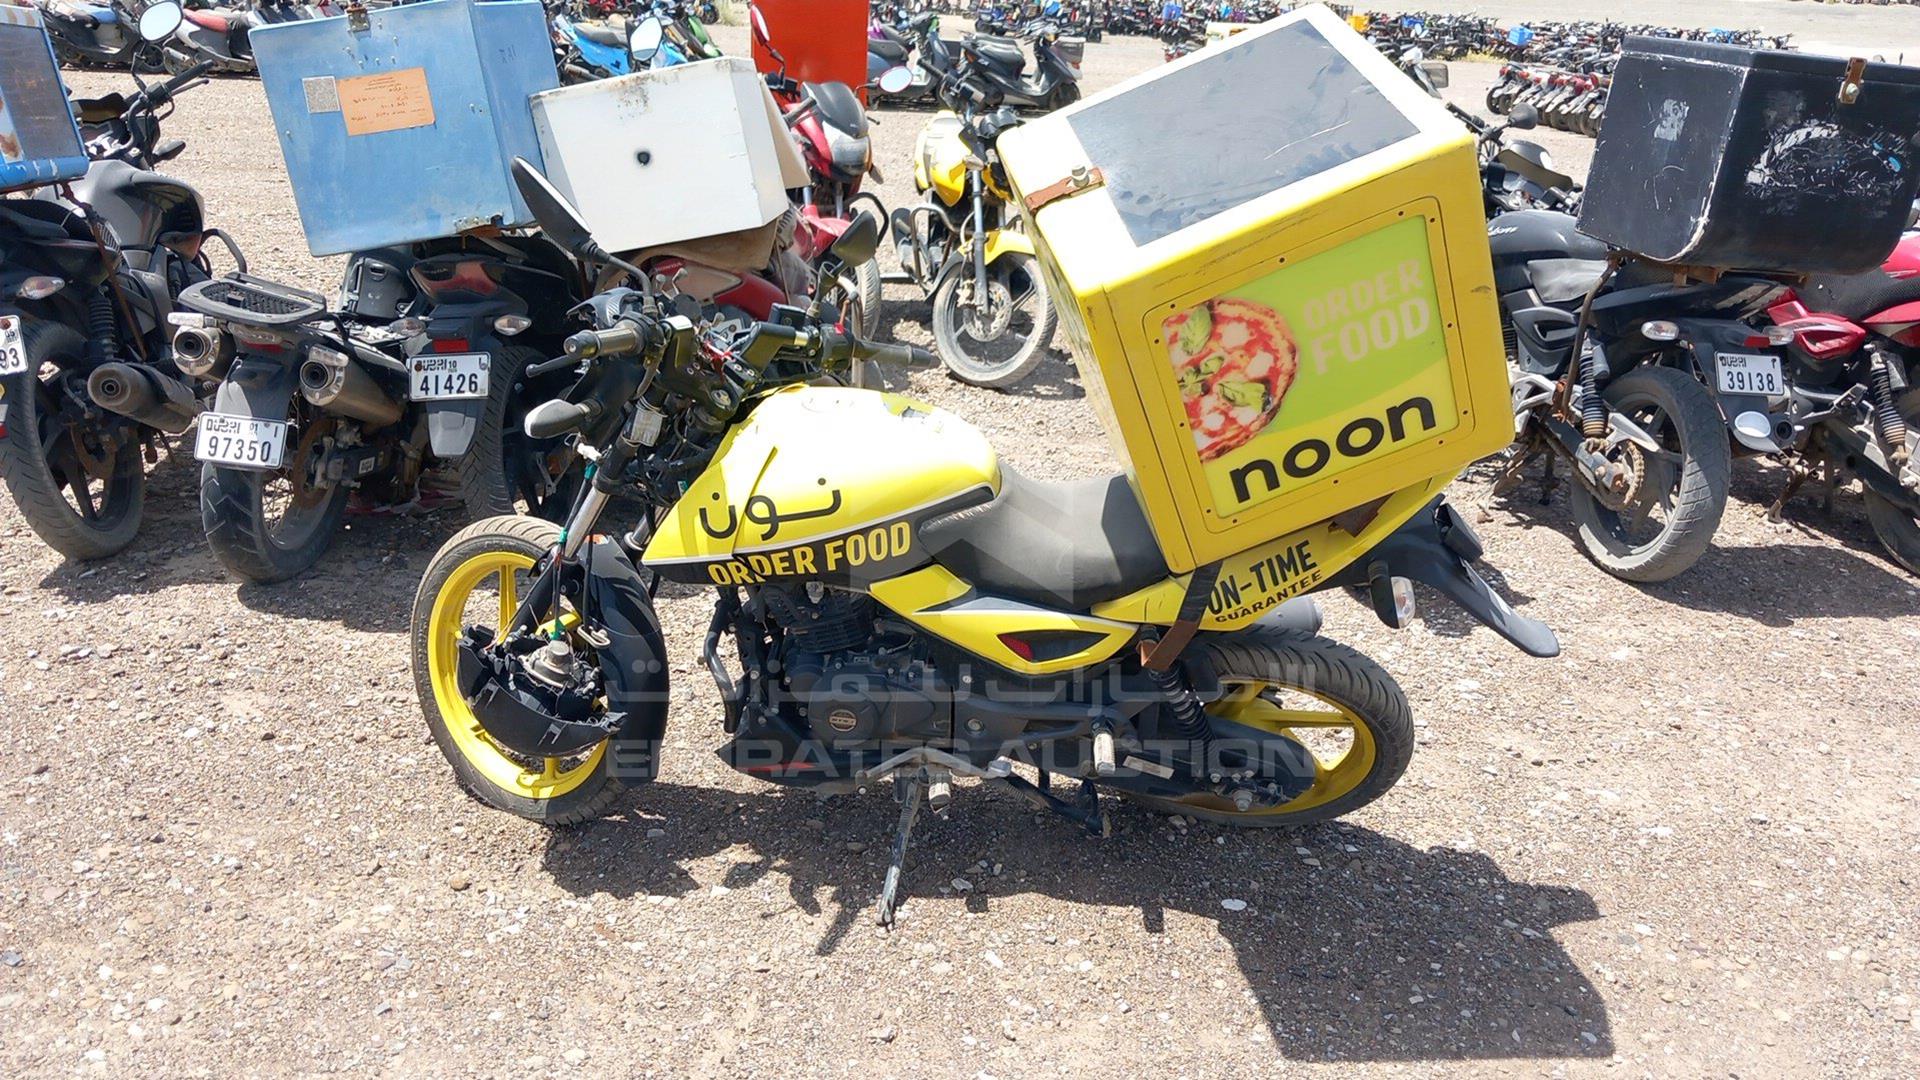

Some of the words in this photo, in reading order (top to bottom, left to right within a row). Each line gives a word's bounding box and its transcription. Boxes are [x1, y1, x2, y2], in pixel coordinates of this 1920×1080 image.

[1303, 258, 1425, 331] ORDER
[1311, 297, 1430, 376] FOOD
[420, 373, 478, 395] 41426
[1727, 371, 1775, 391] 39138
[208, 436, 271, 462] 97350
[249, 422, 258, 432] 01
[1229, 397, 1437, 504] noon
[699, 478, 842, 542] نون
[707, 545, 818, 585] ORDER
[825, 521, 911, 572] FOOD
[1208, 540, 1317, 615] ON-TIME
[1215, 569, 1323, 623] GUARANTEE
